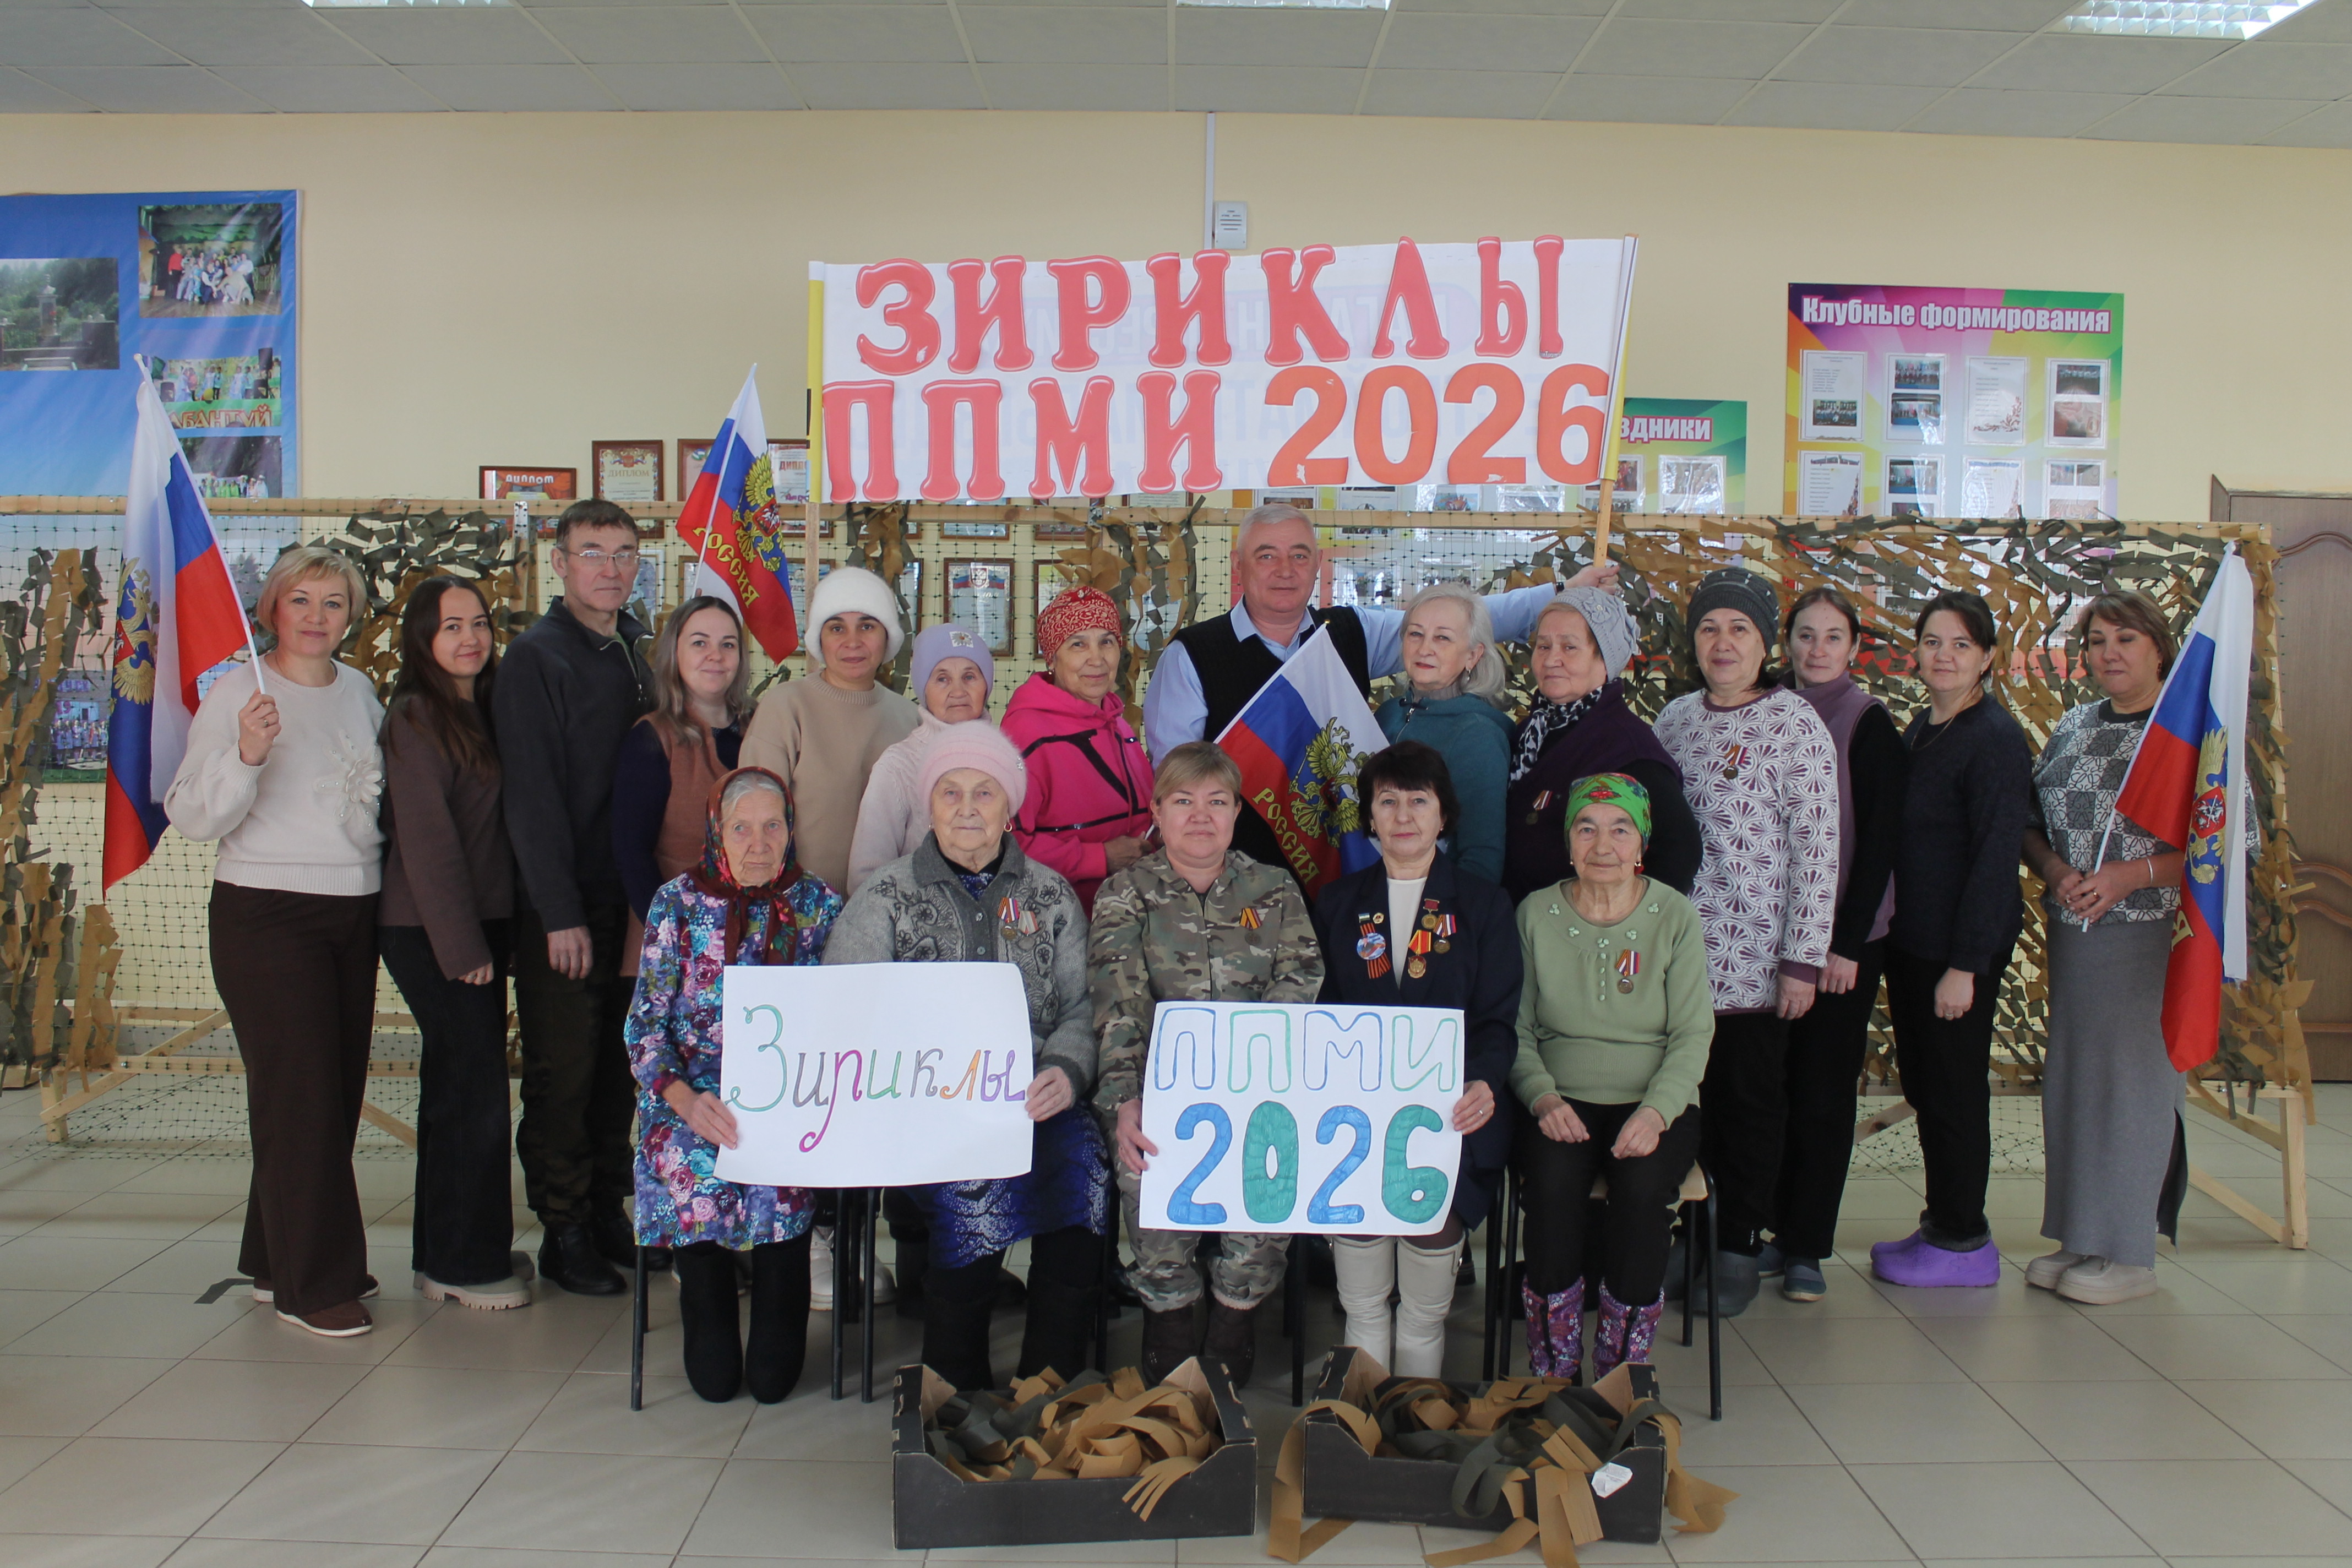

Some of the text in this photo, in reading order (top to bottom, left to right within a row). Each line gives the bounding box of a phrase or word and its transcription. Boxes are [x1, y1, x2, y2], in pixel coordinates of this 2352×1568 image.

[857, 235, 1563, 375] ЗИРИКЛЫ
[1803, 297, 2109, 332] Клубные формирования
[823, 362, 1609, 504] ППМИ 2026
[1252, 787, 1320, 885] РОССИЯ
[725, 1004, 1025, 1152] Зириклы
[1154, 1007, 1457, 1093] ППМИ
[1167, 1101, 1449, 1226] 2026
